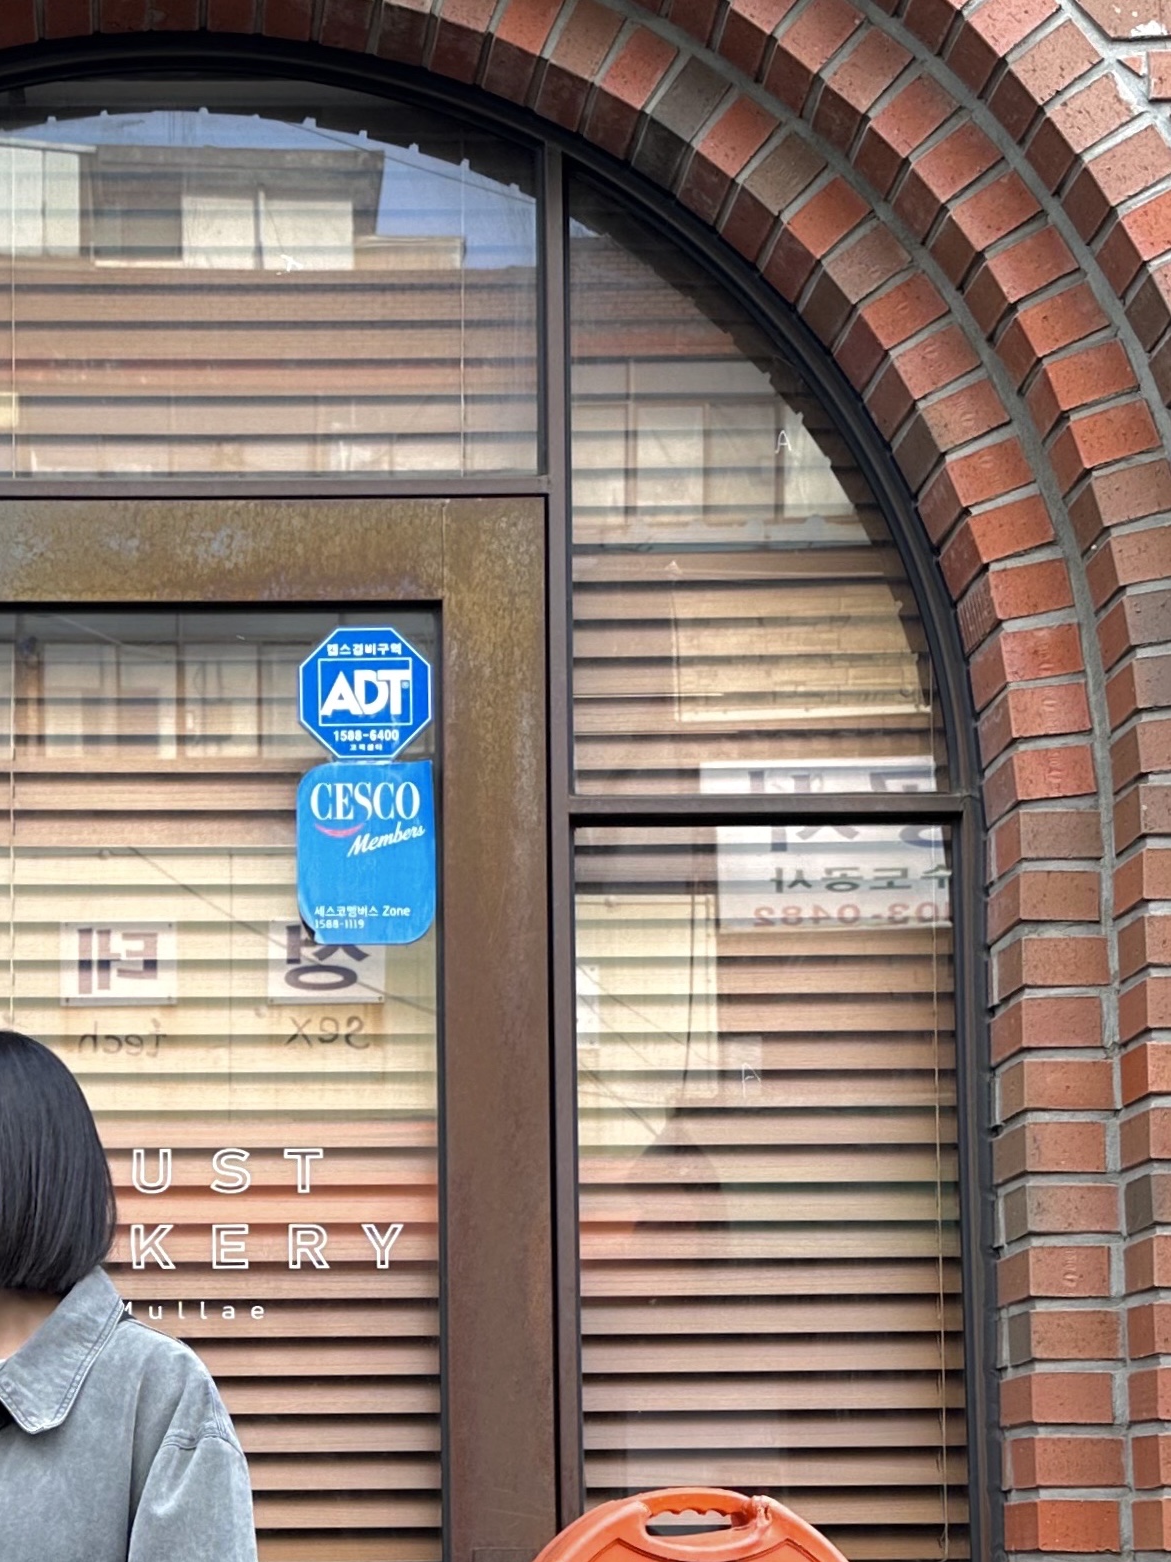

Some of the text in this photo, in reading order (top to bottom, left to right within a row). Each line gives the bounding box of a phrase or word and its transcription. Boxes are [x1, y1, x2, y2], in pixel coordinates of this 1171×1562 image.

[320, 669, 411, 716] ADT
[333, 729, 399, 741] 1588-6400
[310, 781, 420, 821] CESCO
[346, 821, 426, 858] Members
[314, 918, 365, 929] 1588-1119
[382, 905, 411, 917] Zone
[131, 1148, 324, 1194] UST
[130, 1223, 405, 1270] KERY
